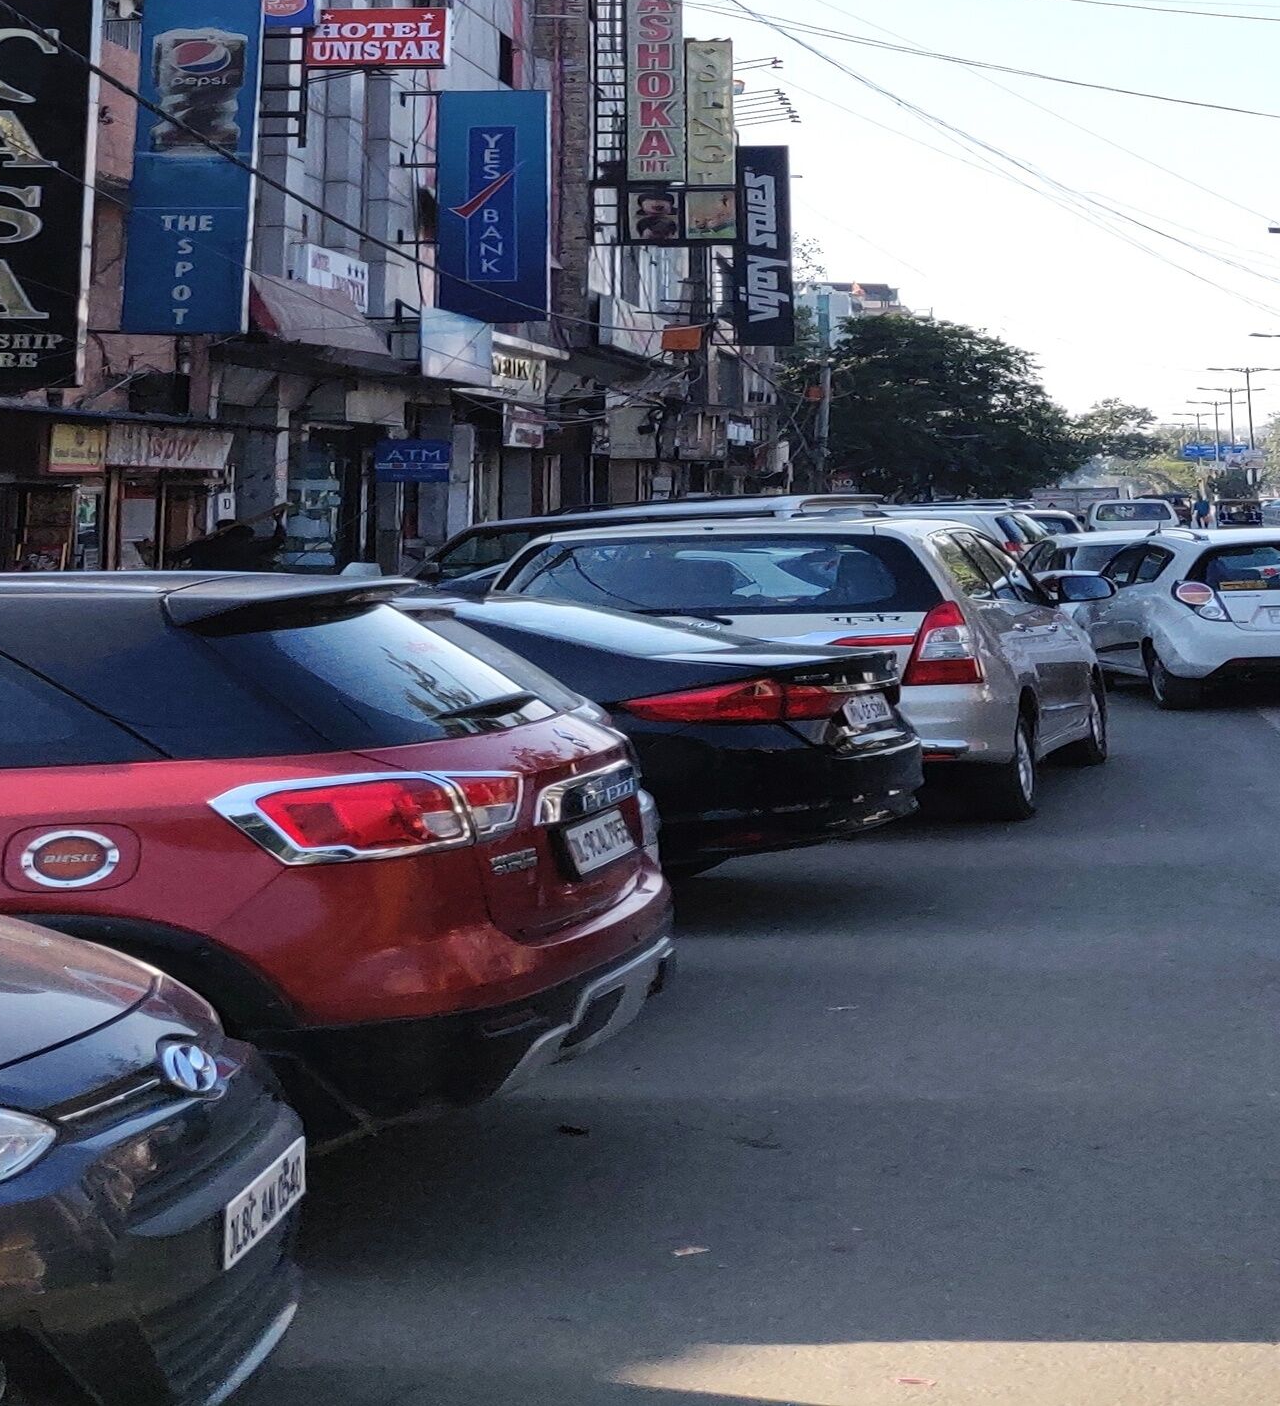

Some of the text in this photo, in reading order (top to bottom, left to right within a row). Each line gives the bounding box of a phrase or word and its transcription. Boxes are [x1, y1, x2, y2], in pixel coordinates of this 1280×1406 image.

[311, 22, 441, 38] HOTEL
[311, 40, 441, 61] UNISTAR
[482, 132, 504, 181] YES
[160, 214, 216, 232] THE
[480, 208, 504, 275] BANK
[171, 238, 196, 326] SPOT
[386, 449, 441, 461] ATM
[42, 853, 100, 864] DIESEL
